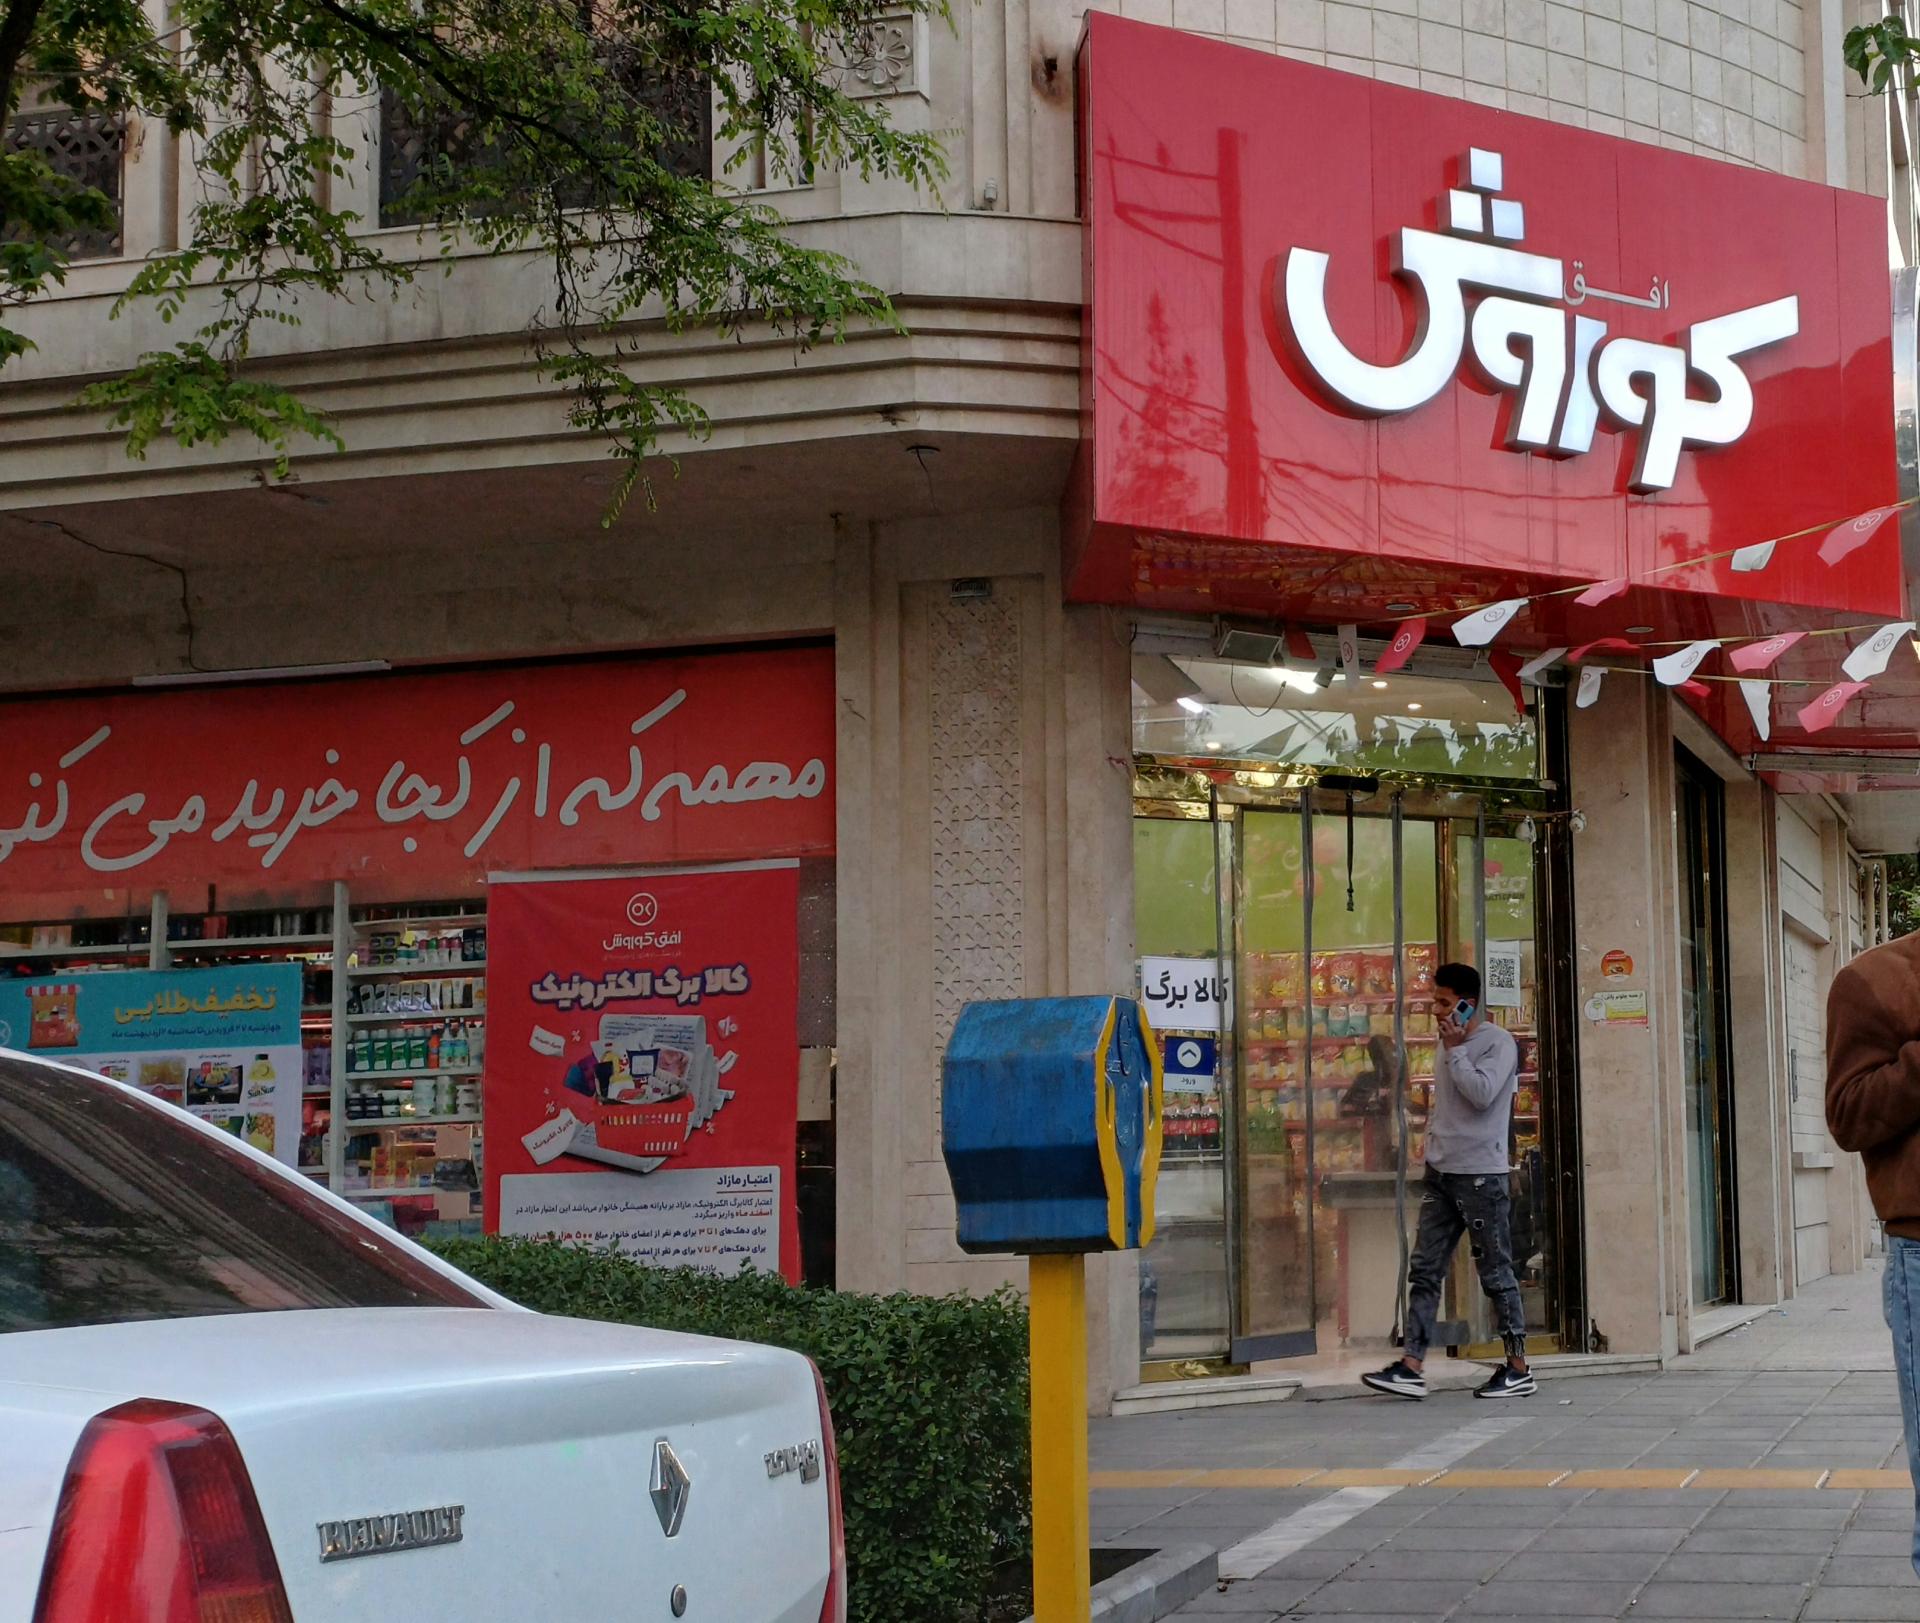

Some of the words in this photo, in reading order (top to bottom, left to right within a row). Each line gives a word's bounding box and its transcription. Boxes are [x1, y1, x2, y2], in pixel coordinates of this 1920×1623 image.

[1564, 260, 1670, 309] افق
[1286, 146, 1799, 489] کوروش
[211, 748, 359, 868] خرید
[603, 932, 655, 951] کوروش
[655, 930, 681, 948] افق
[704, 964, 749, 994] کالا
[532, 969, 652, 1009] الکترونیک
[654, 967, 701, 1005] برگ
[1145, 969, 1188, 1009] برگ
[115, 990, 190, 1025] طلایی
[191, 985, 277, 1020] تخفیف
[717, 1175, 742, 1187] مازاد
[742, 1173, 772, 1187] اعتبار
[599, 1203, 618, 1212] خانوار
[755, 1198, 772, 1208] اعتبار
[524, 1205, 539, 1214] مازاد
[750, 1209, 772, 1217] اسفند
[575, 1230, 592, 1239] ۵۰۰
[654, 1229, 660, 1238] از
[661, 1229, 671, 1238] نفر
[673, 1230, 681, 1238] هر
[682, 1228, 696, 1237] برای
[752, 1226, 766, 1235] برای
[594, 1231, 608, 1241] مبلغ
[661, 1247, 671, 1256] نفر
[672, 1248, 680, 1256] هر
[682, 1246, 695, 1255] برای
[752, 1244, 766, 1254] برای
[316, 1504, 465, 1564] RENAULT
